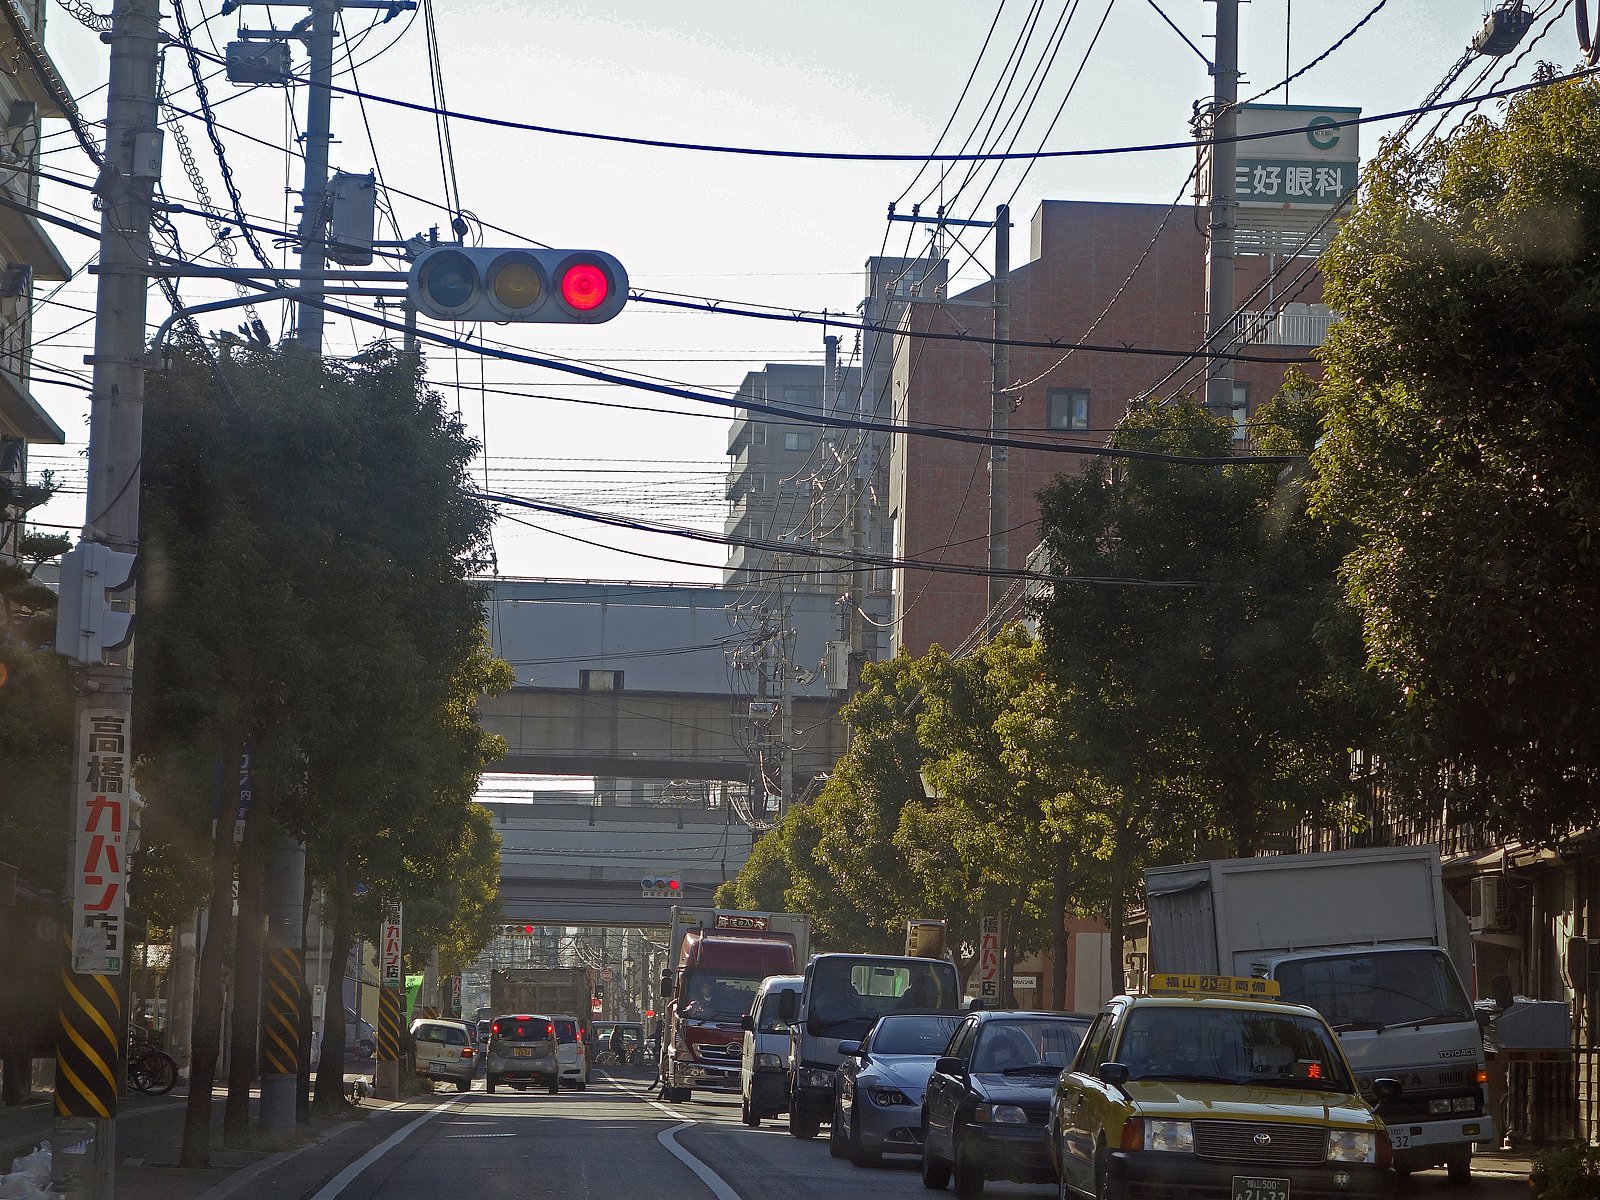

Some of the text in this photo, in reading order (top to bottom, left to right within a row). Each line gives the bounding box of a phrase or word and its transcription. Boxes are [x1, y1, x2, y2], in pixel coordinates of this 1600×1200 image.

[1236, 165, 1343, 198] 三好眼科
[1165, 976, 1266, 992] 福山 小型 両備
[1438, 1048, 1476, 1058] TOYOACE
